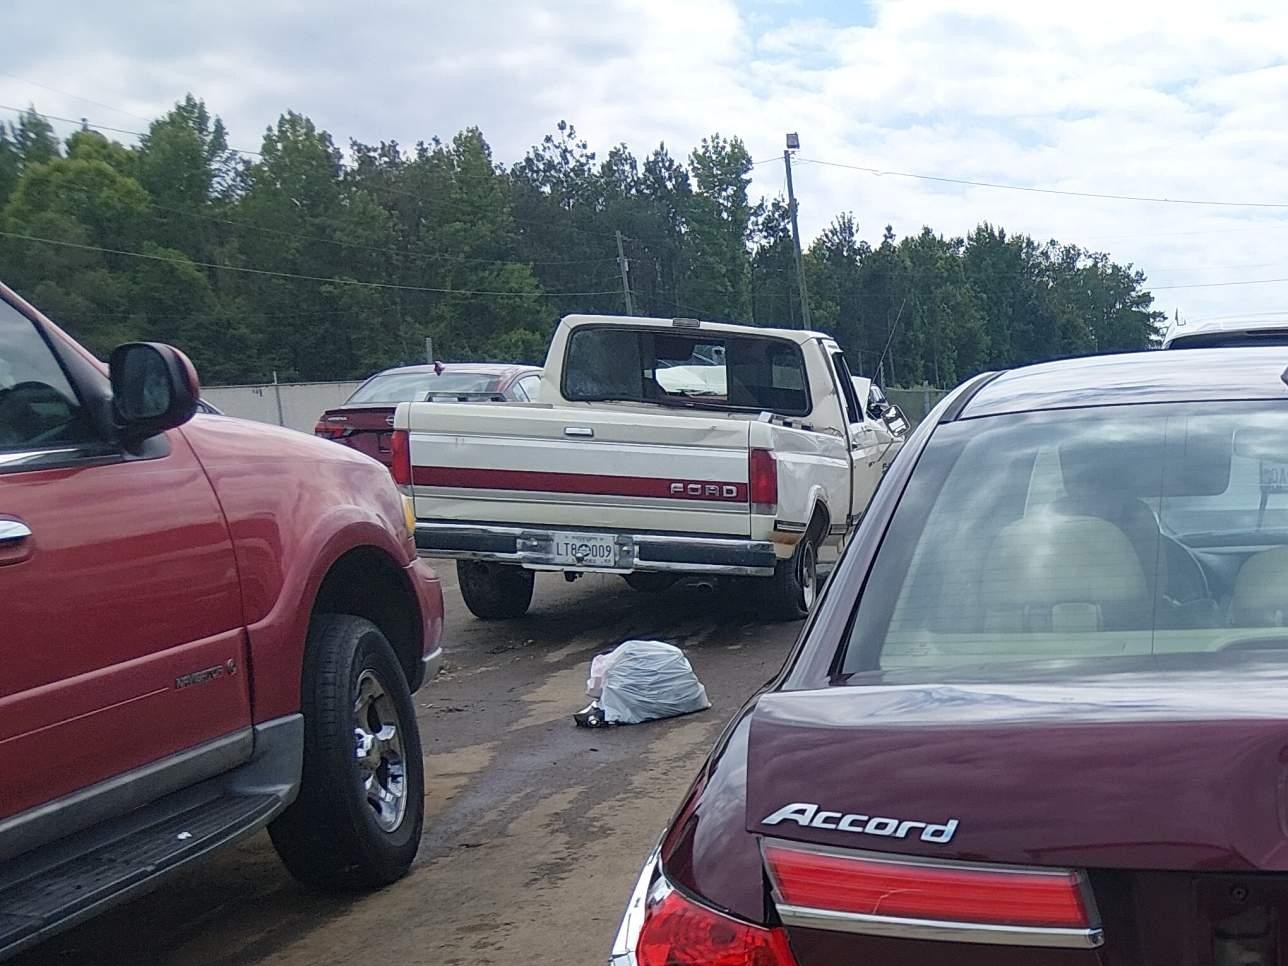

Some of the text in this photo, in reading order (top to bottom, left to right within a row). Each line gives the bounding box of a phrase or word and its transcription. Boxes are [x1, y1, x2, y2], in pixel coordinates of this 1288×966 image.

[670, 482, 737, 497] FORD
[591, 544, 612, 558] 009
[761, 802, 960, 844] Accord
